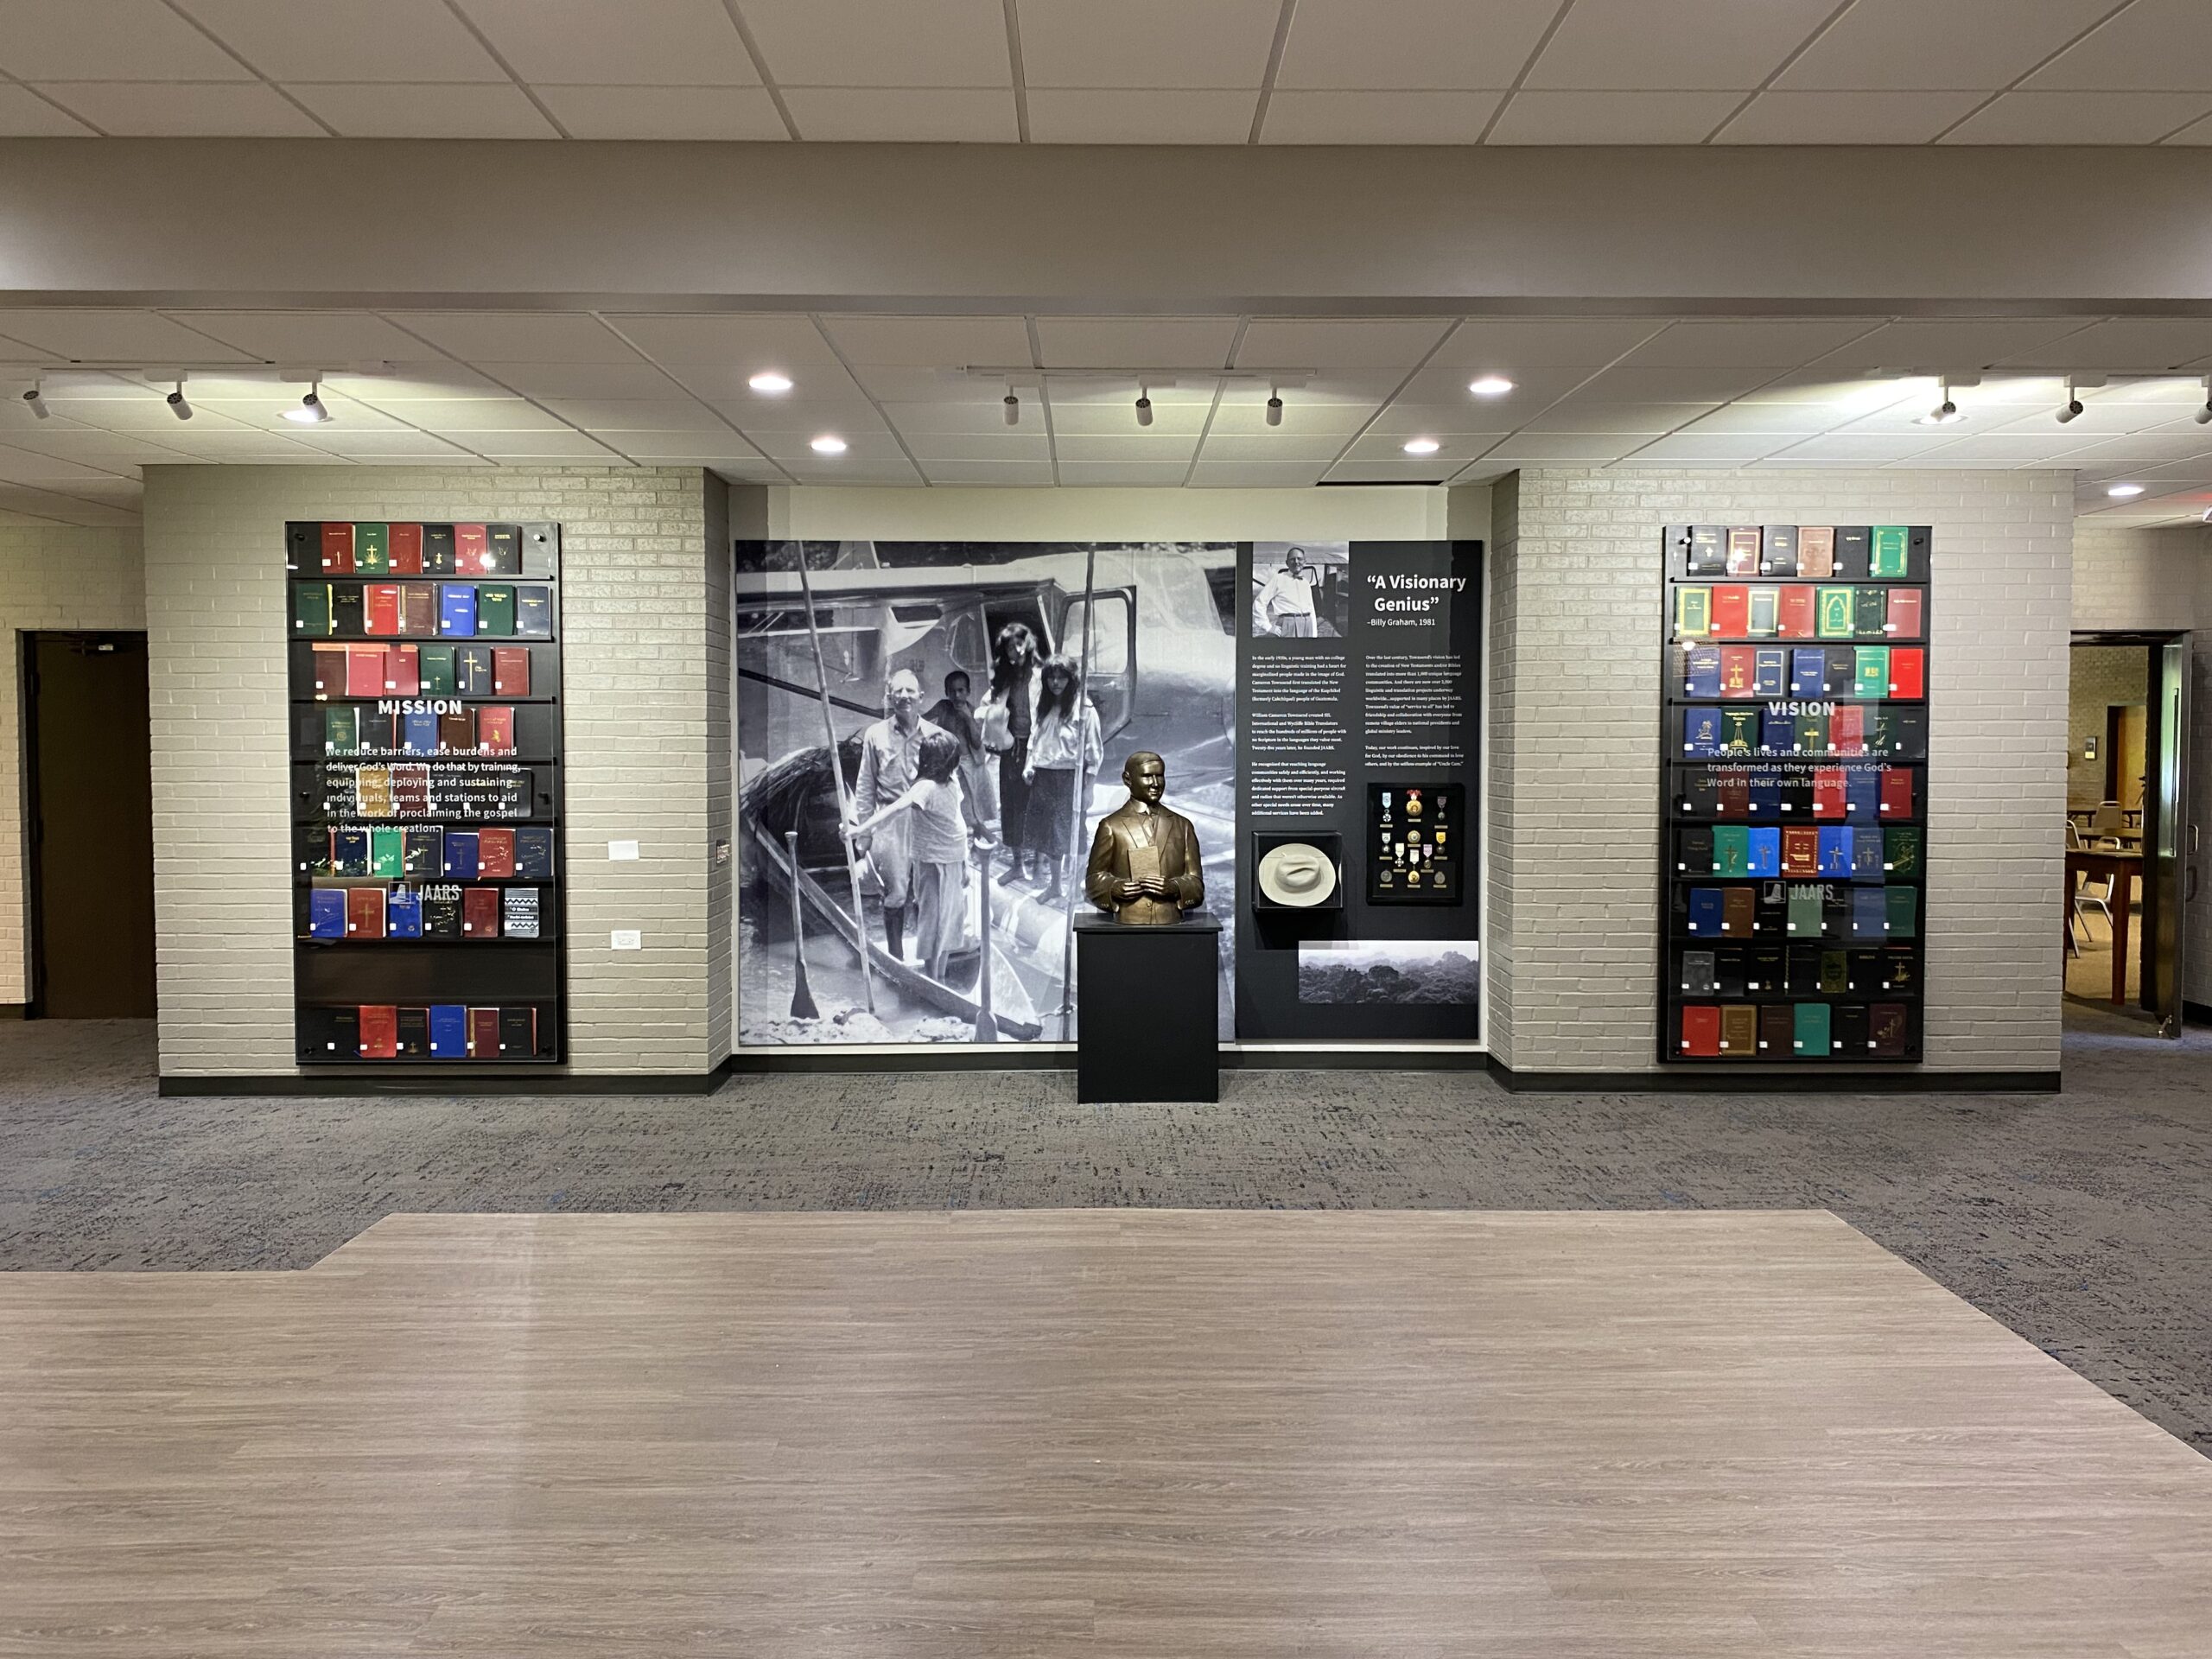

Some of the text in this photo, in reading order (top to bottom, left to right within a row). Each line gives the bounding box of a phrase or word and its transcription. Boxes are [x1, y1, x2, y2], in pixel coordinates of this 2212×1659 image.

[1367, 574, 1466, 592] "A Visionary
[1374, 596, 1440, 612] Genius"
[378, 700, 462, 715] MISSION
[1769, 702, 1835, 716] VISION
[343, 747, 378, 756] reduce
[381, 747, 424, 757] barriers,
[453, 747, 495, 755] burdens
[498, 747, 518, 756] and
[1708, 747, 1751, 759] People's
[1753, 747, 1777, 756] lives
[1780, 747, 1800, 756] and
[1802, 747, 1869, 756] communities
[326, 762, 521, 773] deliver God's Word. We do that by training,
[1707, 762, 1769, 772] transformed
[1783, 762, 1806, 773] they
[1808, 763, 1864, 774] experience
[1864, 763, 1892, 772] God's
[384, 778, 435, 788] deploying
[437, 778, 456, 786] and
[459, 778, 512, 788] sustaining
[1707, 778, 1734, 787] Word
[1737, 778, 1746, 786] in
[1750, 778, 1775, 787] their
[1802, 778, 1852, 789] language.
[327, 793, 386, 804] indiviuals,
[423, 793, 442, 802] and
[444, 793, 486, 802] stations
[501, 792, 518, 802] aid
[327, 808, 518, 819] in the work of proclaiming the gospel
[327, 823, 439, 833] to the whole creation.
[416, 884, 460, 900] JAARS
[1790, 884, 1834, 900] JAARS
